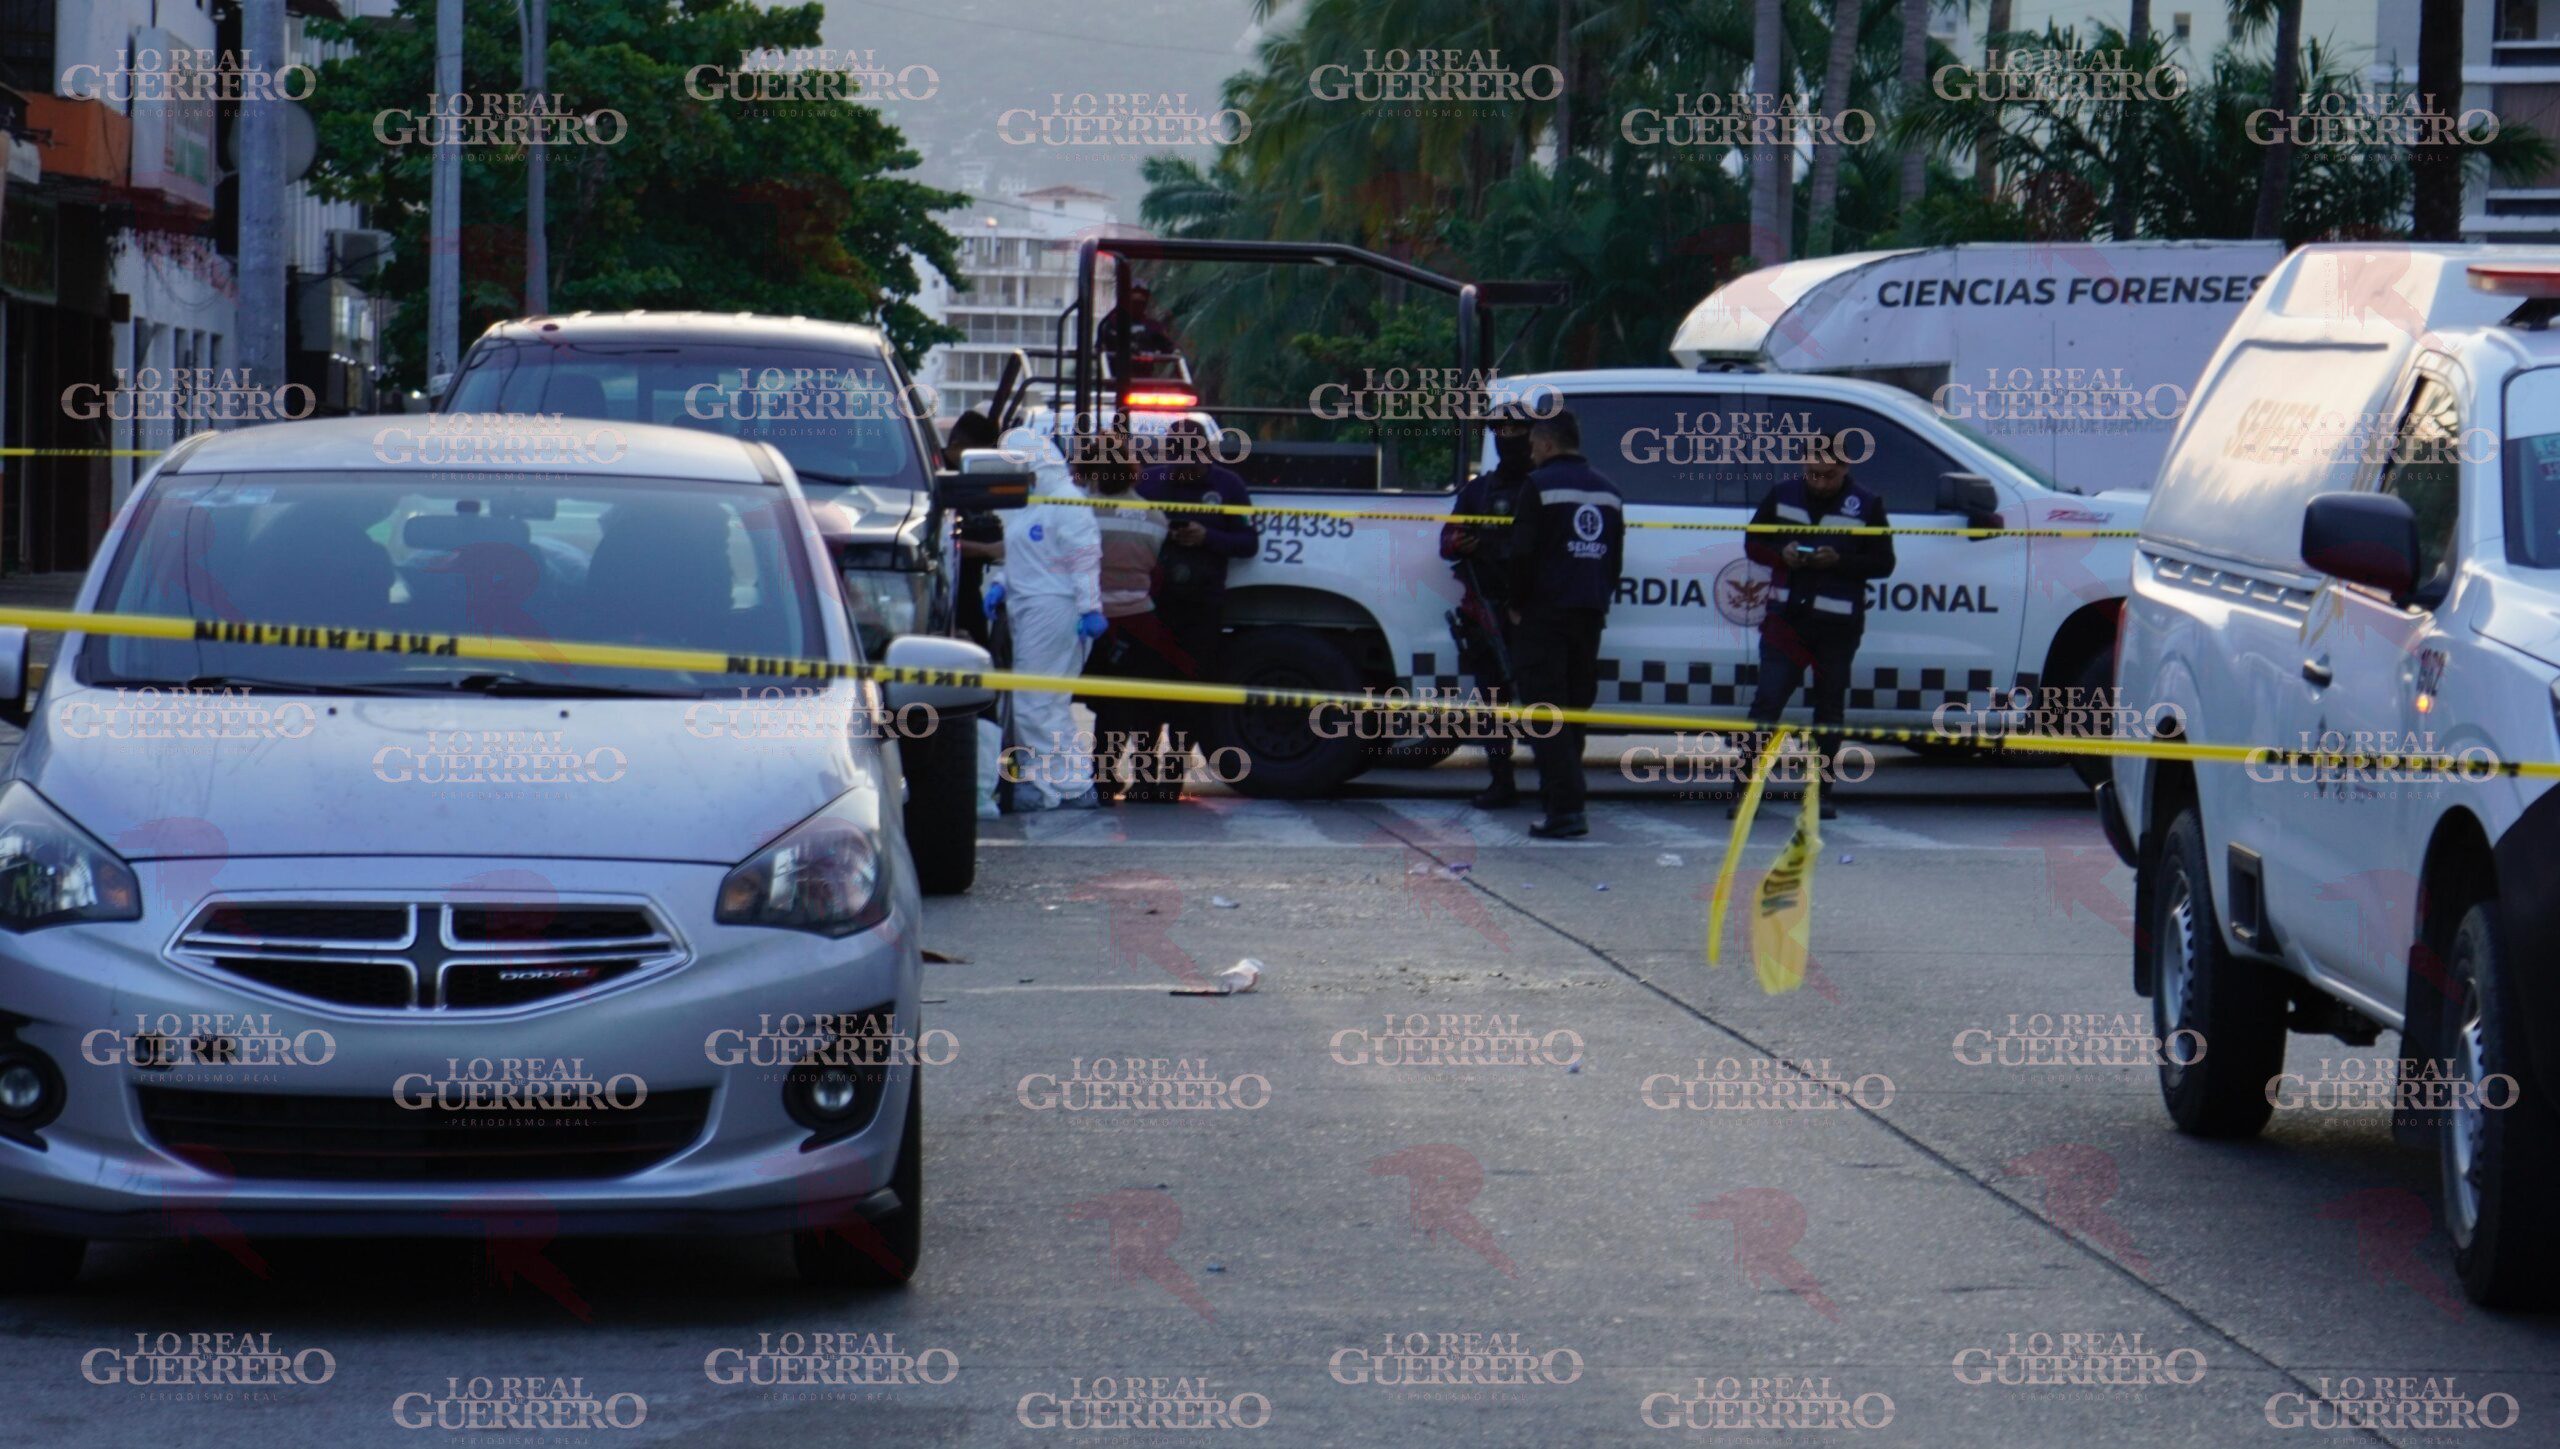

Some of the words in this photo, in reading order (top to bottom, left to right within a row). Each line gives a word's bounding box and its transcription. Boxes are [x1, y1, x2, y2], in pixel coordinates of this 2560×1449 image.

[1878, 278, 2056, 308] CIENCIAS
[1263, 539, 1304, 564] 52
[1614, 577, 1707, 607] RDIA
[1864, 582, 1999, 613] CIONAL
[500, 968, 590, 980] DODGE
